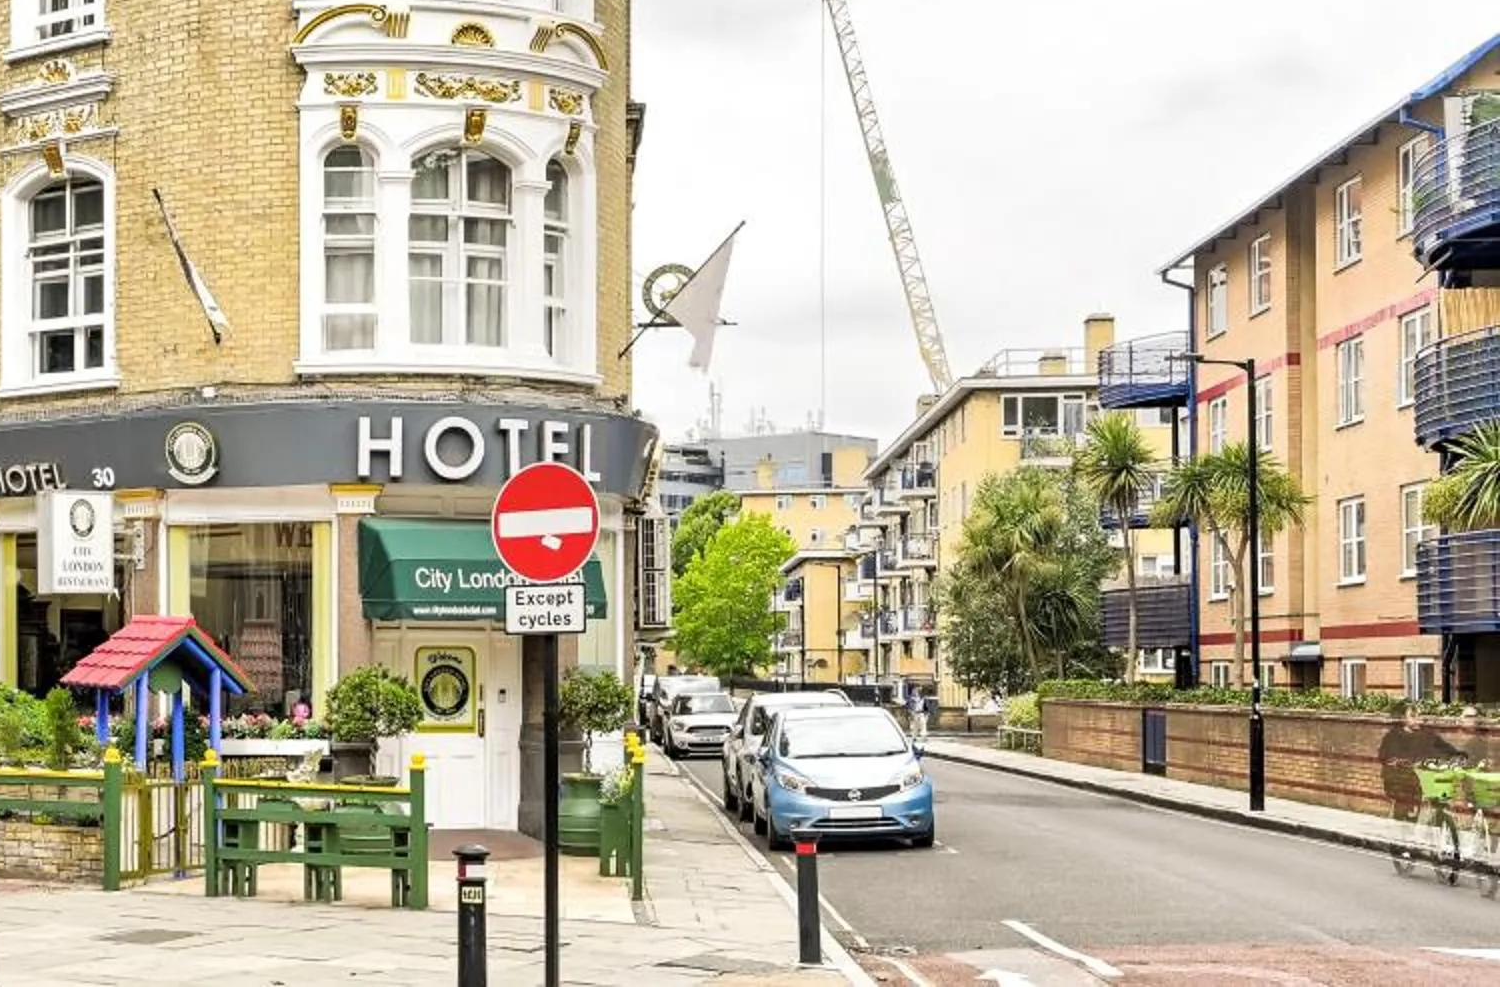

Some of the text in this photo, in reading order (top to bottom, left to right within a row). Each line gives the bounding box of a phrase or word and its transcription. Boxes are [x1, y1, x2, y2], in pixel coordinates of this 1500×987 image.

[356, 416, 601, 483] HOTEL
[92, 467, 116, 488] 30
[62, 560, 104, 573] LONDON
[414, 568, 452, 594] City
[515, 590, 574, 607] Except
[518, 613, 572, 629] cycles
